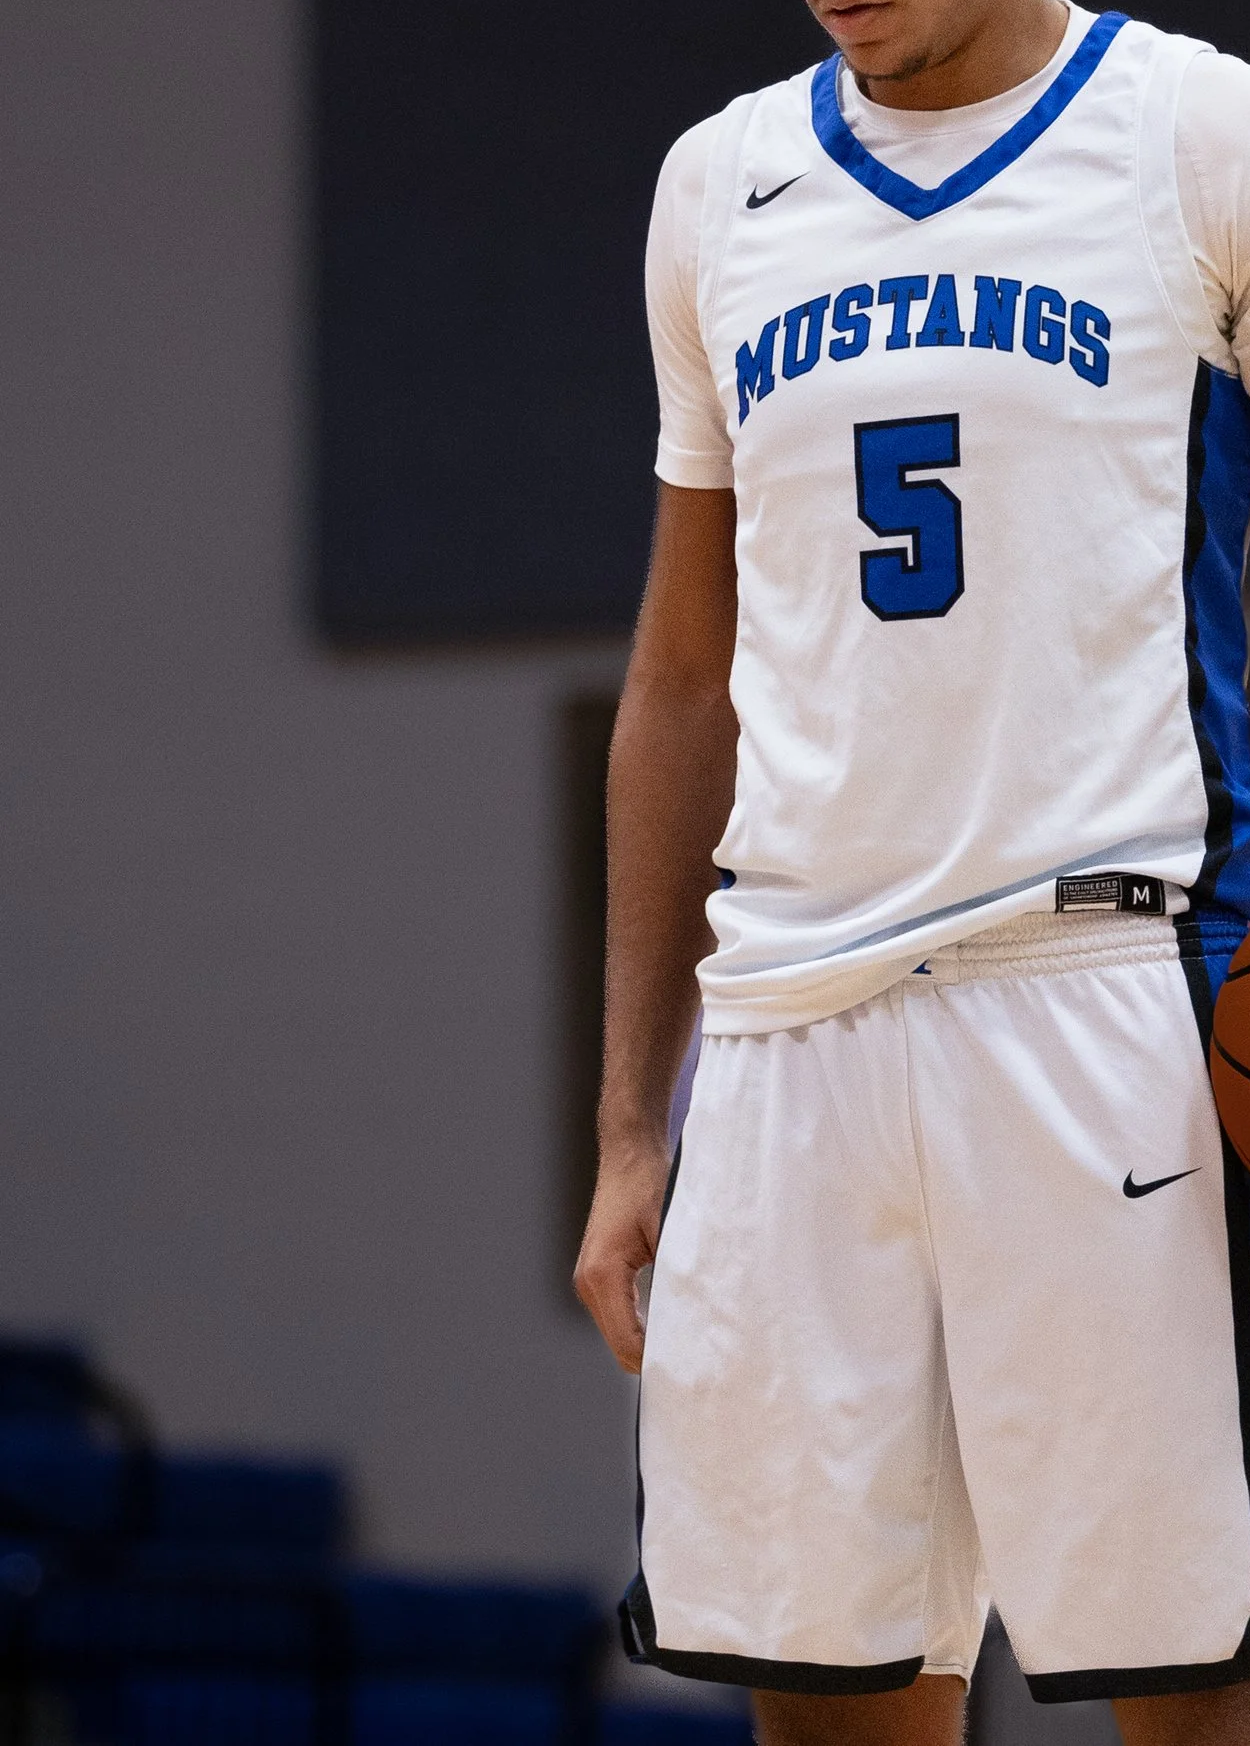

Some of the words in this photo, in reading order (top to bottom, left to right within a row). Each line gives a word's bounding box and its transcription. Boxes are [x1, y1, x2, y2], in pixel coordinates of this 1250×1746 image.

[734, 274, 1111, 427] MUSTANGS
[853, 413, 965, 622] 5
[1063, 880, 1118, 891] ENGINEERED
[1132, 885, 1151, 906] M
